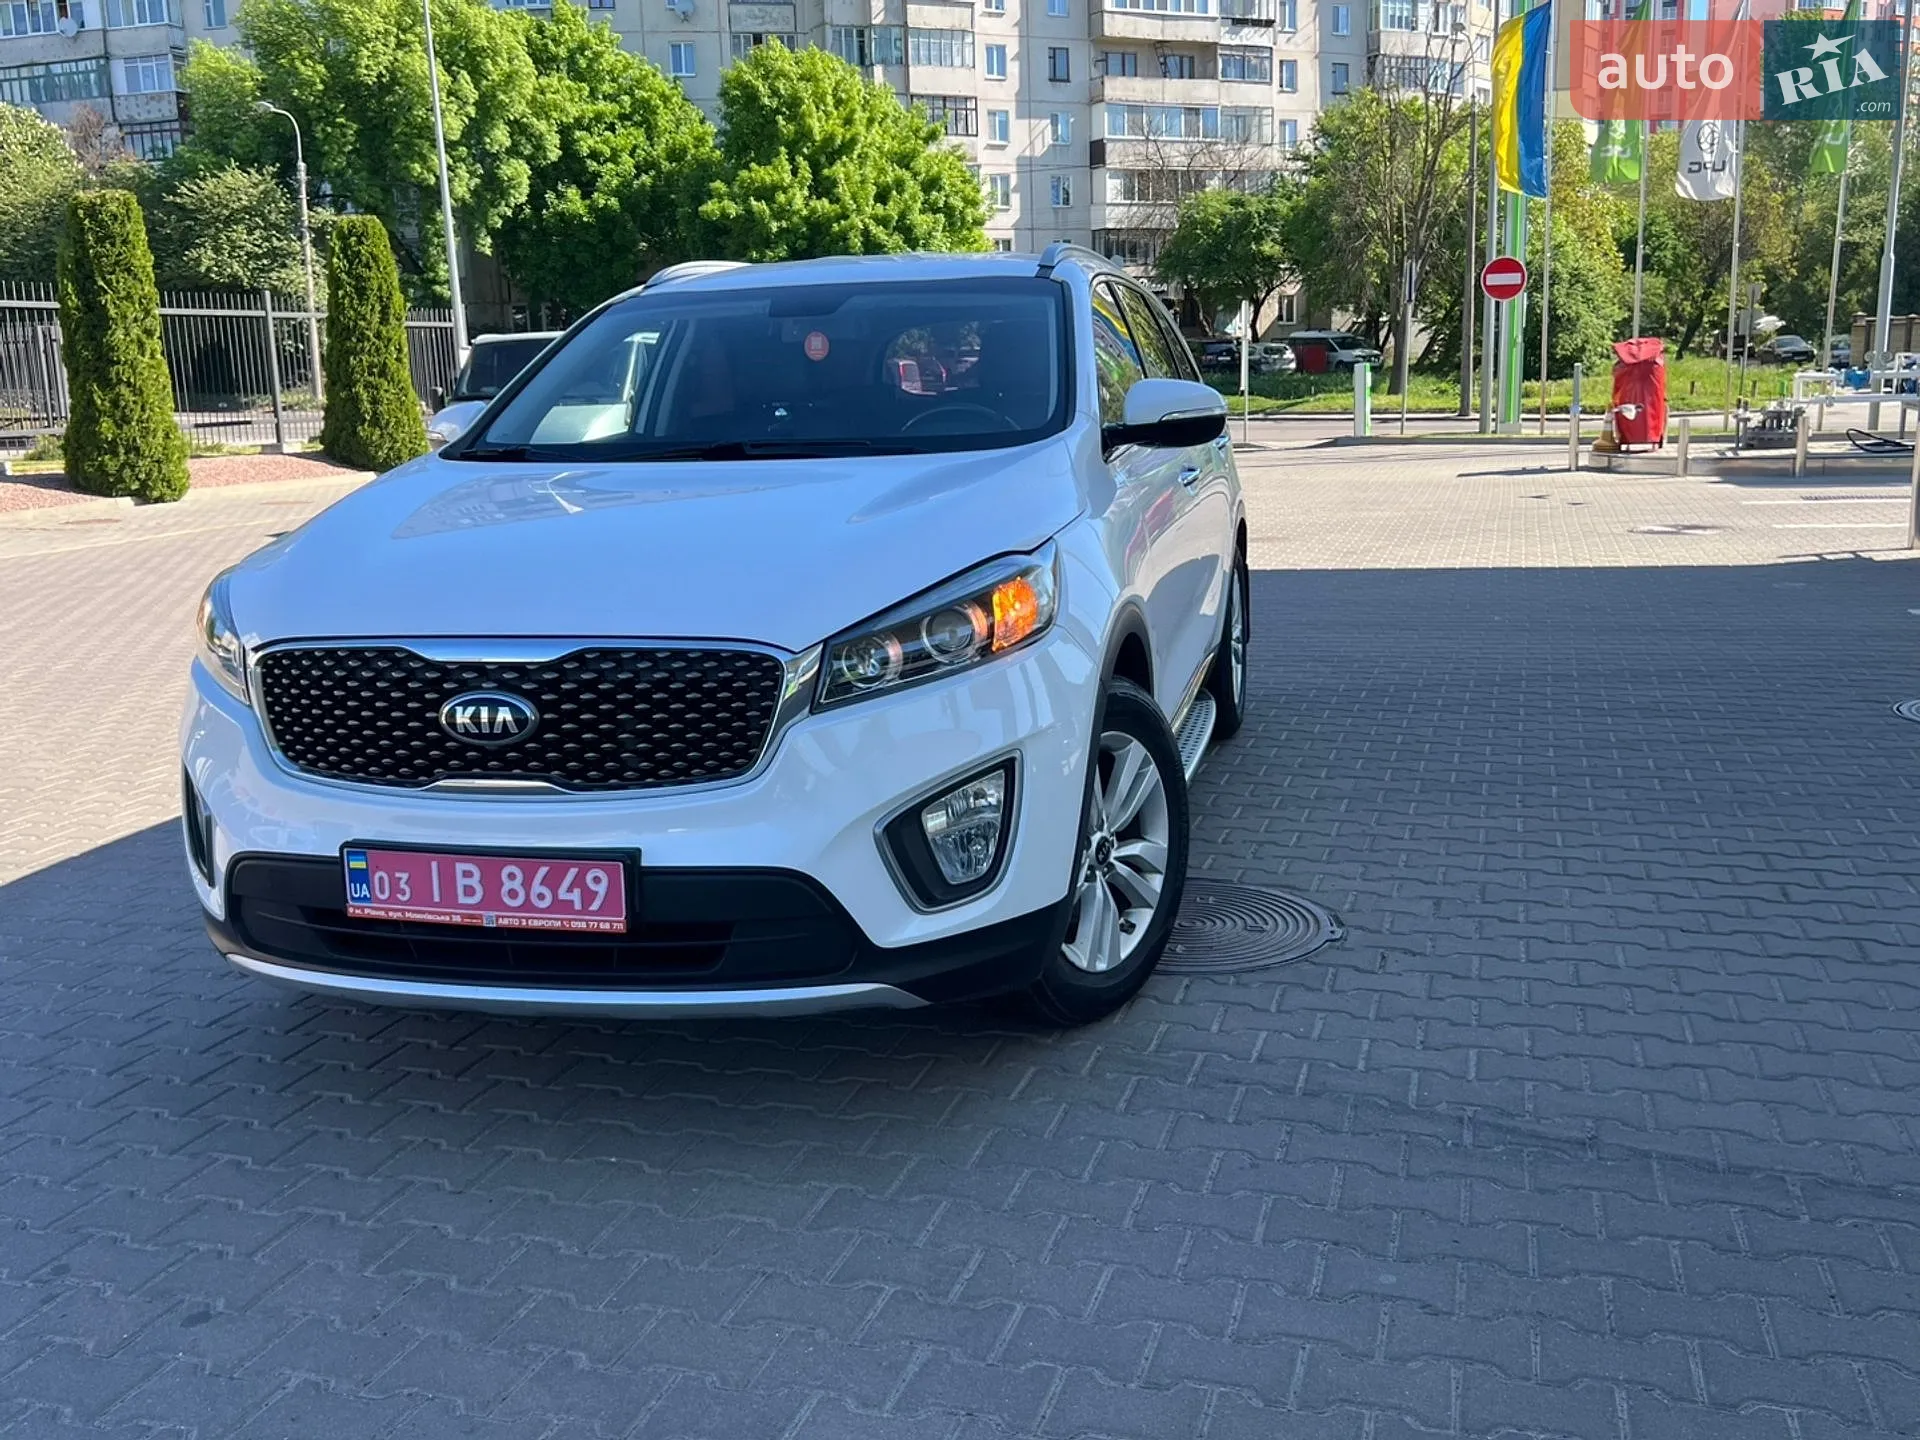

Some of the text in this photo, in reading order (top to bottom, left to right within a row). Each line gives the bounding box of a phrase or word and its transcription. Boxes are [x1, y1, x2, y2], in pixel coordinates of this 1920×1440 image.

[454, 706, 519, 734] KIA
[351, 883, 370, 898] UA
[374, 871, 411, 900] 03
[500, 864, 609, 911] 8649
